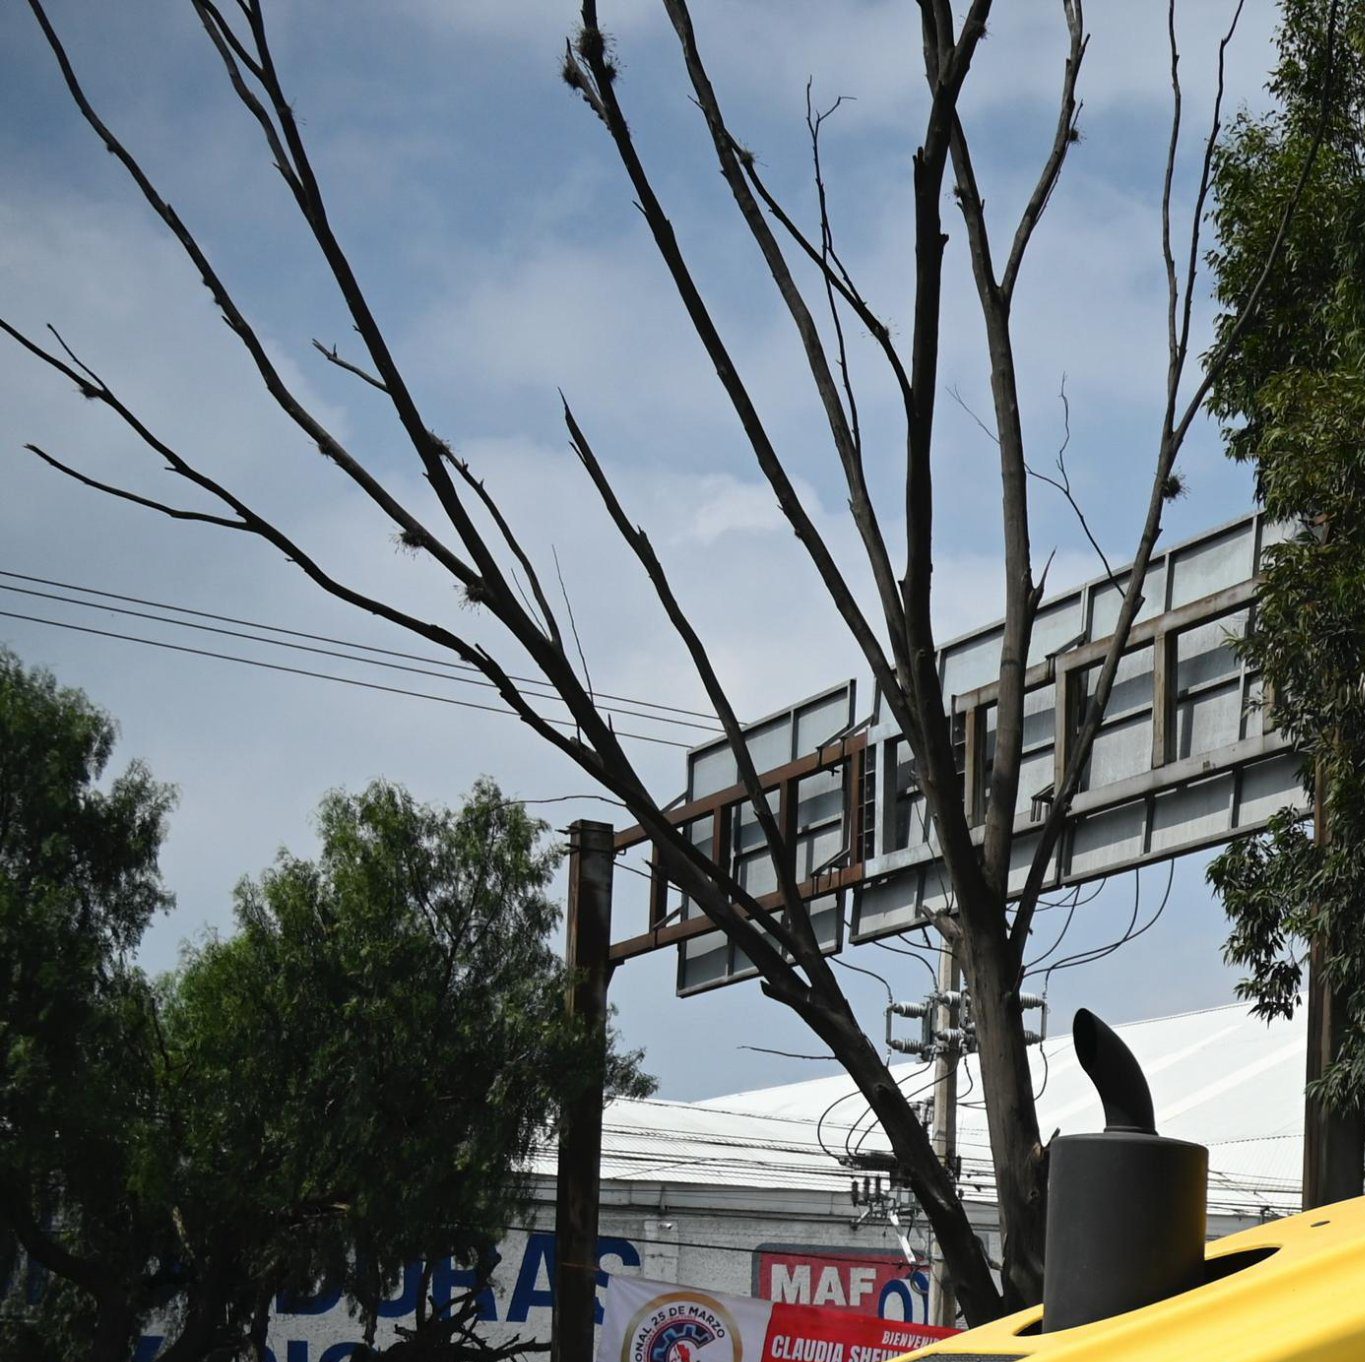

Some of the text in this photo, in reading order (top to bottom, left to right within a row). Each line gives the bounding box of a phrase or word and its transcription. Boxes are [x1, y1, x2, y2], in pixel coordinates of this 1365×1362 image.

[770, 1263, 877, 1307] MAF
[651, 1311, 666, 1327] 25
[668, 1305, 686, 1317] DE
[688, 1306, 726, 1339] MARZO
